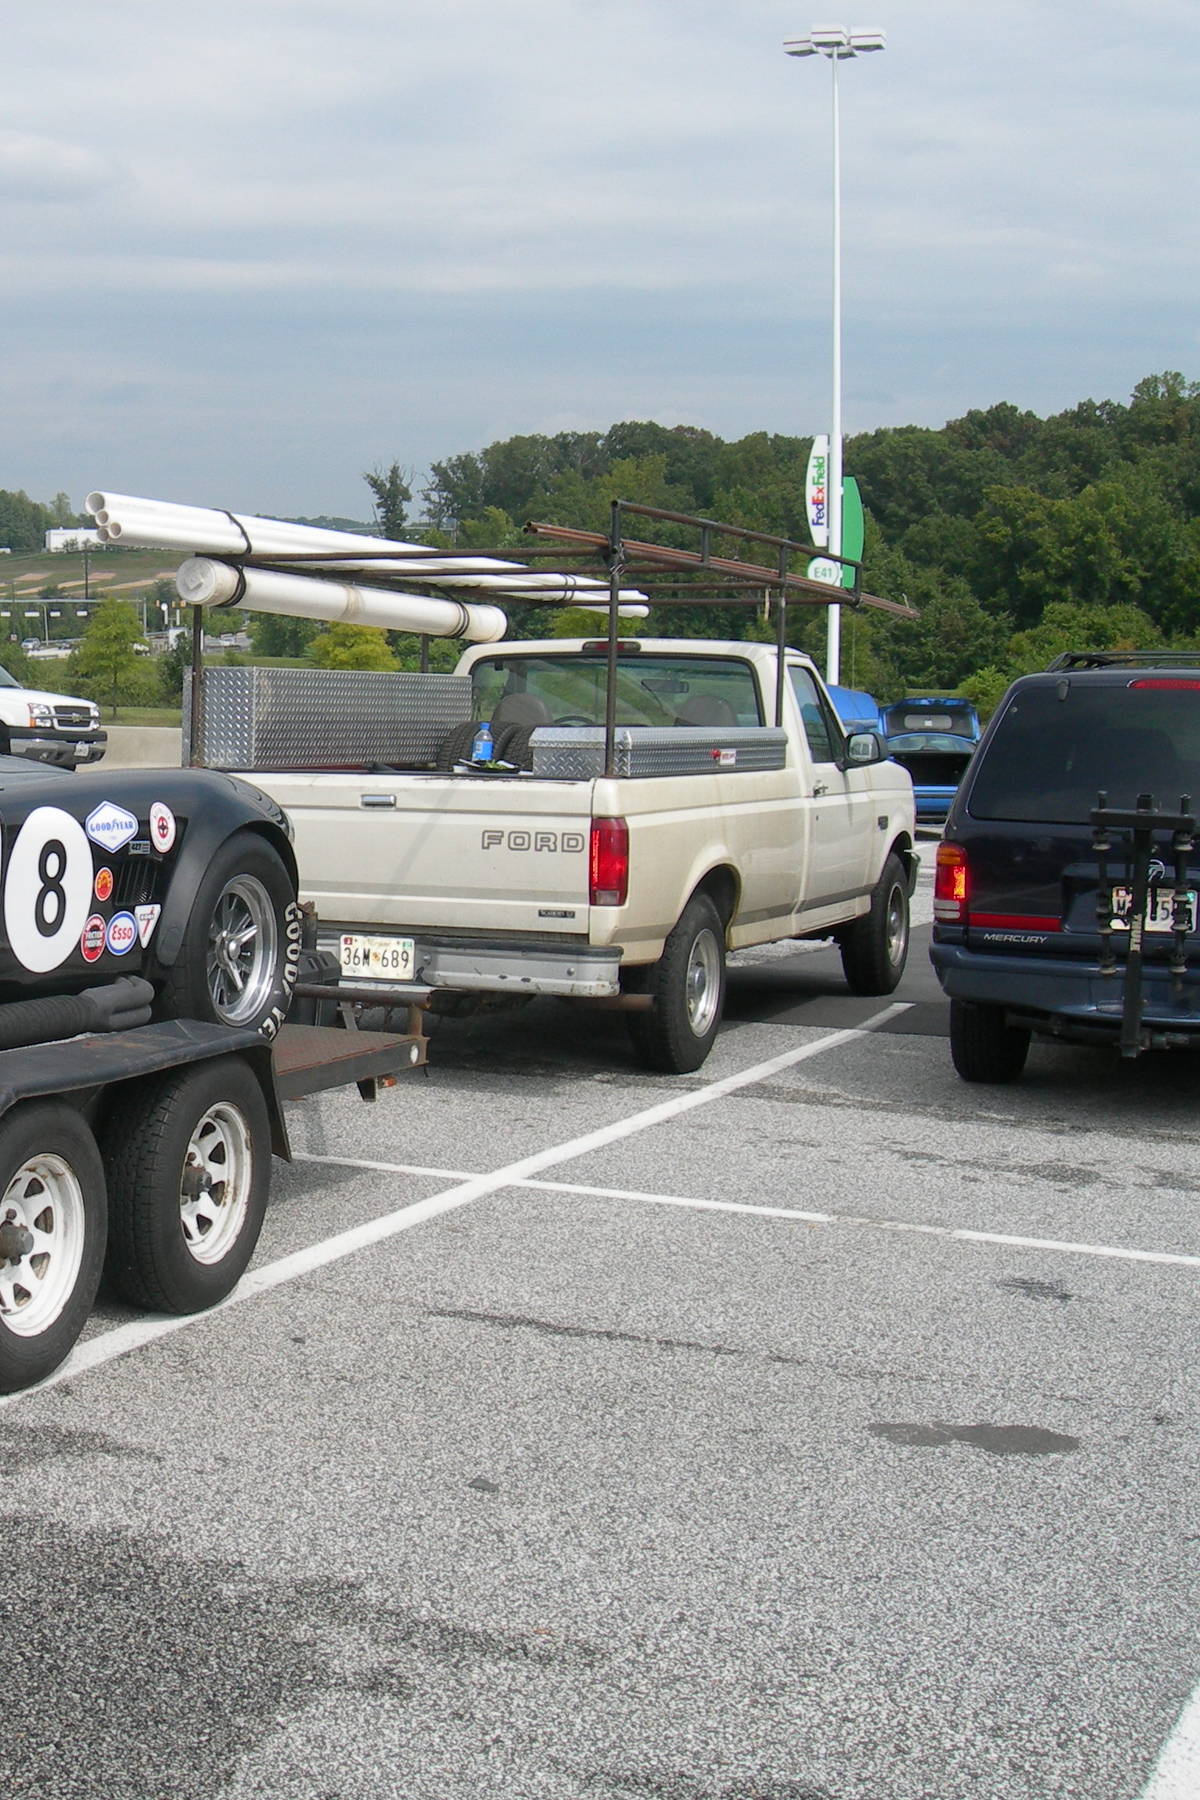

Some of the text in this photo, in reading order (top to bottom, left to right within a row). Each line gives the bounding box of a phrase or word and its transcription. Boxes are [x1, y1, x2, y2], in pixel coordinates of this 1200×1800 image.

[814, 567, 832, 578] E41
[90, 819, 134, 832] GOODYEAR
[481, 830, 585, 853] FORD
[35, 839, 67, 938] 8
[983, 933, 1048, 944] MERCURY
